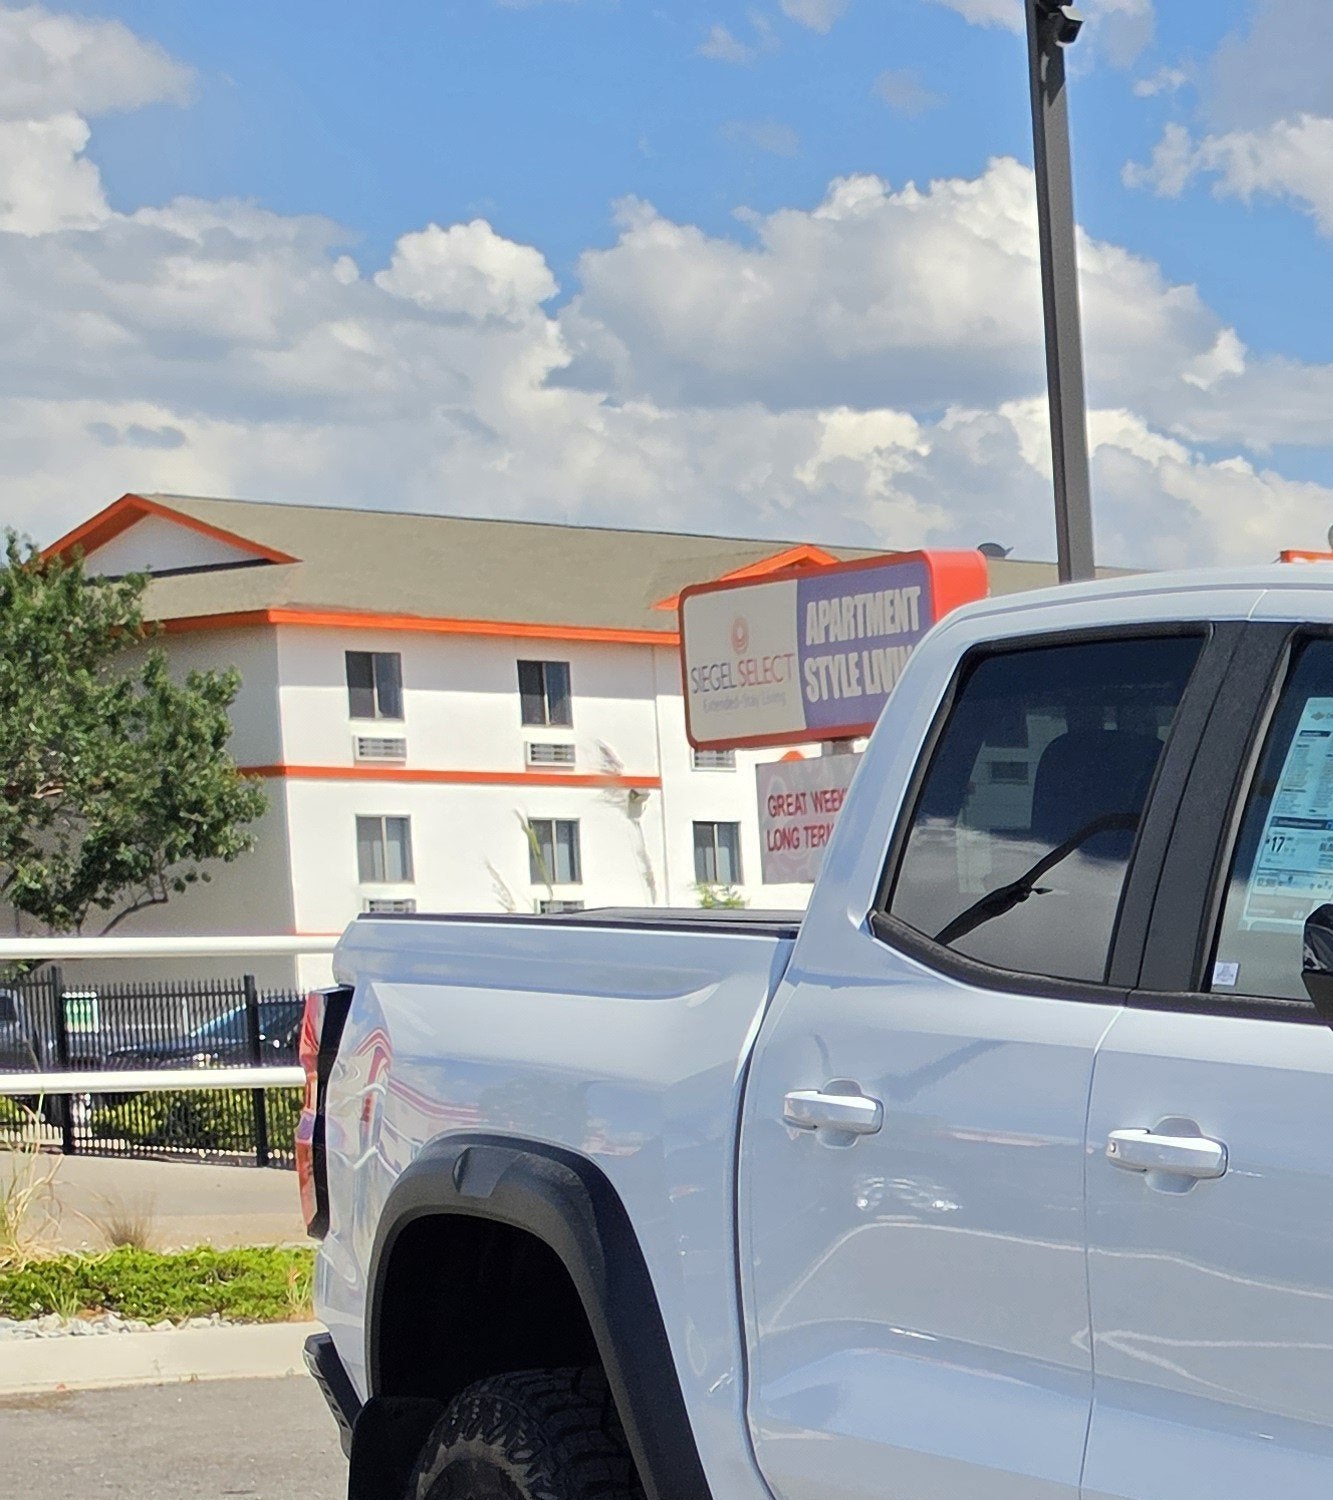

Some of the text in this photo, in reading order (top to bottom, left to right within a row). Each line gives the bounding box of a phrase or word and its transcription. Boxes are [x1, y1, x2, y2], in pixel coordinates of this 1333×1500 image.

[806, 586, 921, 647] APARTMENT
[690, 653, 795, 694] SIEGEL SELECT
[804, 652, 862, 703] STYLE
[768, 792, 807, 818] GREAT
[767, 826, 800, 852] LONG
